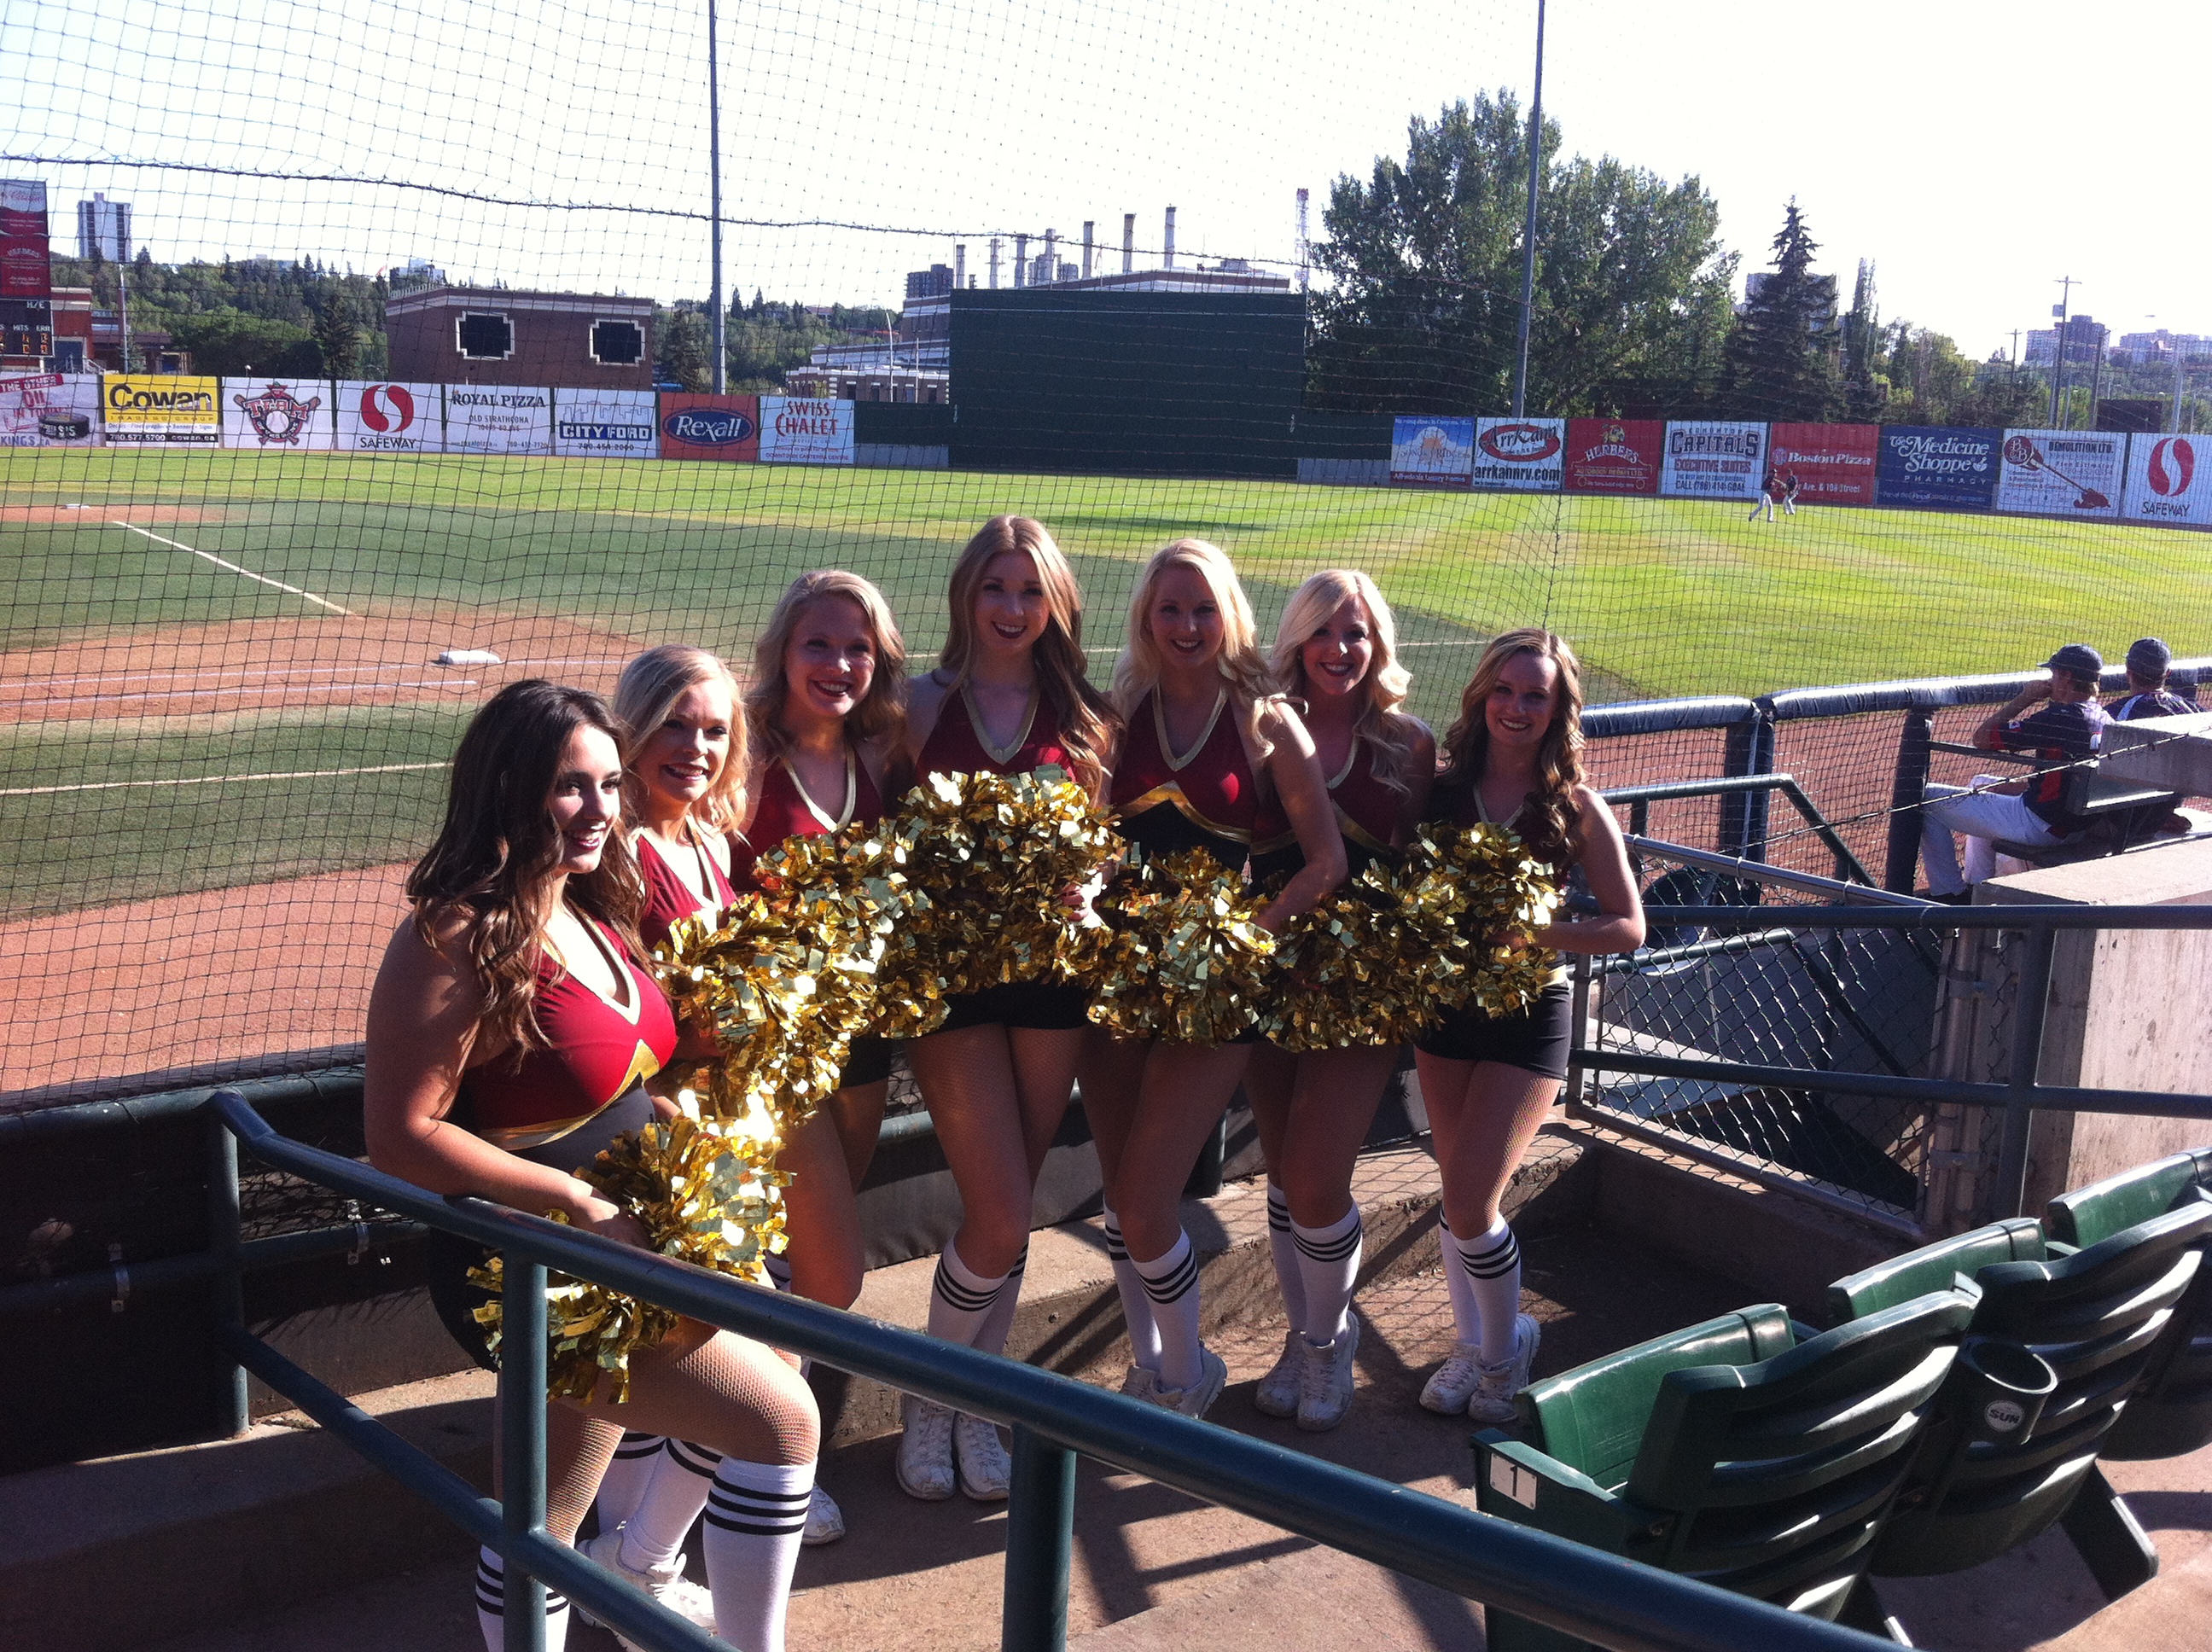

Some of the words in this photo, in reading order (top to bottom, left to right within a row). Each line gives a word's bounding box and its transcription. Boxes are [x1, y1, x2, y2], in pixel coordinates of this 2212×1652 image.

[1, 381, 20, 393] THE
[24, 376, 56, 389] OTHER
[24, 390, 52, 408] OIL
[109, 384, 212, 410] Cowan
[453, 393, 498, 406] ROYAL
[501, 395, 546, 407] PIZZA
[788, 400, 830, 416] SWISS
[485, 416, 529, 424] STRATHCONA
[775, 413, 838, 437] CHALET
[563, 426, 604, 438] CITY
[608, 427, 649, 439] FORD
[676, 416, 742, 442] Rexall
[360, 437, 416, 449] SAFEWAY
[1670, 430, 1760, 457] CAPITALS
[1897, 435, 1989, 457] Medicine
[2010, 437, 2022, 451] B
[1585, 445, 1639, 464] HERBERS
[1788, 452, 1835, 464] Boston
[1836, 453, 1872, 465] Pizza
[2018, 447, 2028, 462] B
[1905, 452, 1971, 474] Shoppe
[1475, 464, 1561, 481] arrkannrv.com
[1904, 475, 1987, 485] PHARMACY
[1676, 480, 1692, 490] CALL
[2141, 501, 2191, 517] SAFEWAY
[1989, 1409, 2020, 1424] SUN
[1510, 1464, 1518, 1498] 1
